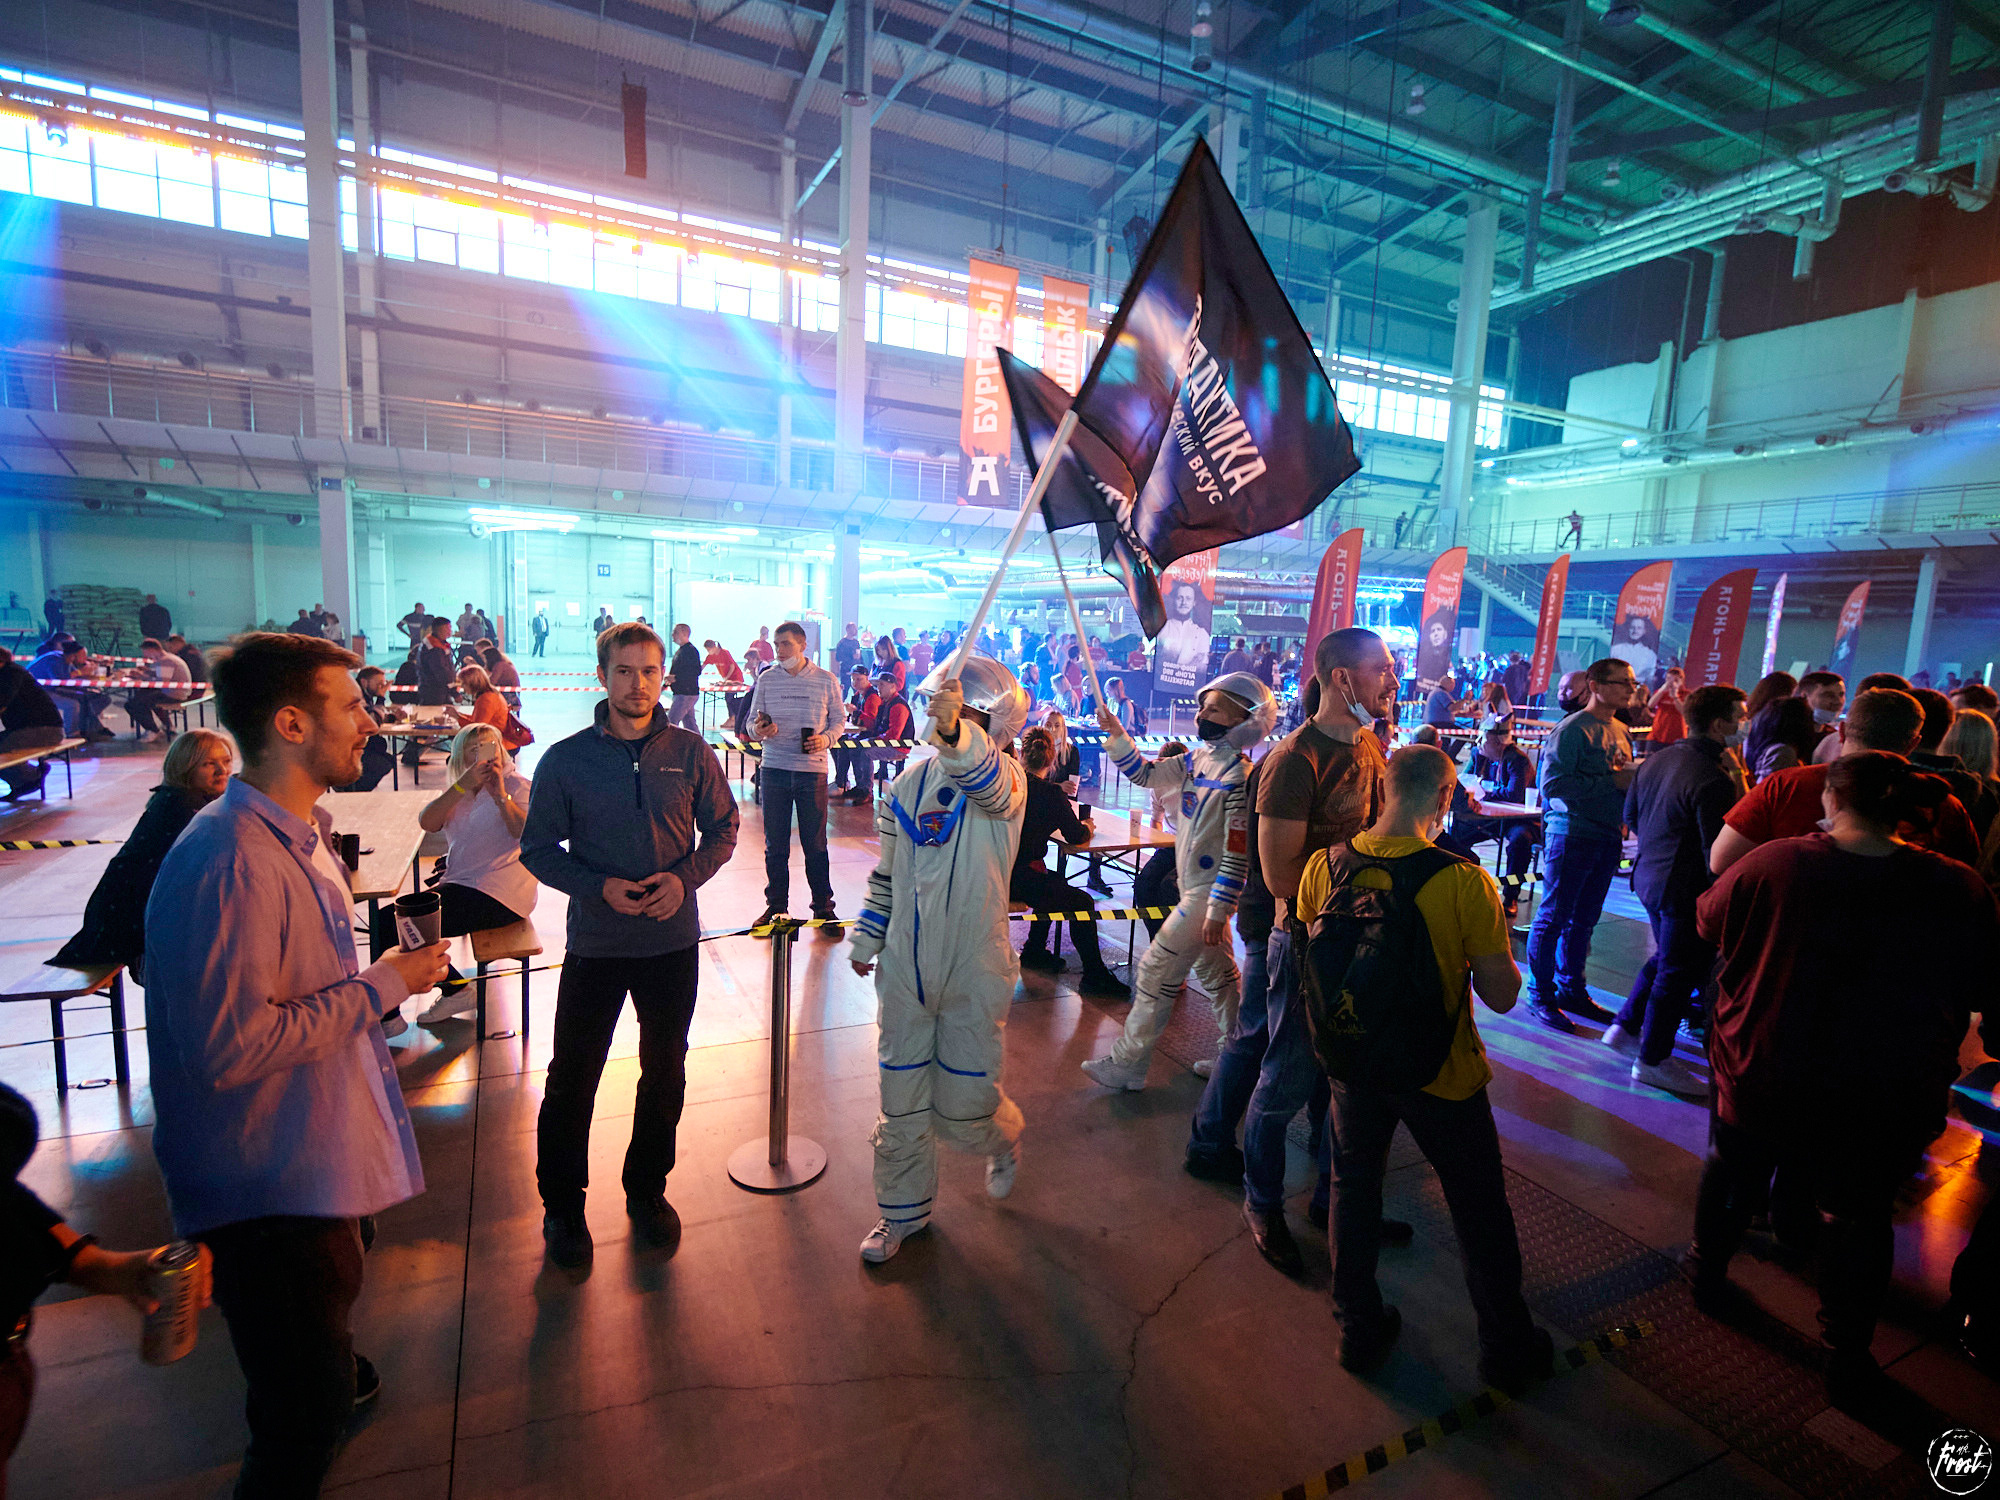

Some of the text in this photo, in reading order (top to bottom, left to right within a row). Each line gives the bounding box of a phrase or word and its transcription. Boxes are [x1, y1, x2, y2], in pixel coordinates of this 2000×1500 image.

[973, 290, 1004, 433] БУРГЕРЫ
[1056, 305, 1077, 397] ШЛЫК
[1186, 293, 1267, 496] ЛАКТИКА
[1188, 454, 1223, 504] вкус
[599, 566, 609, 575] 15
